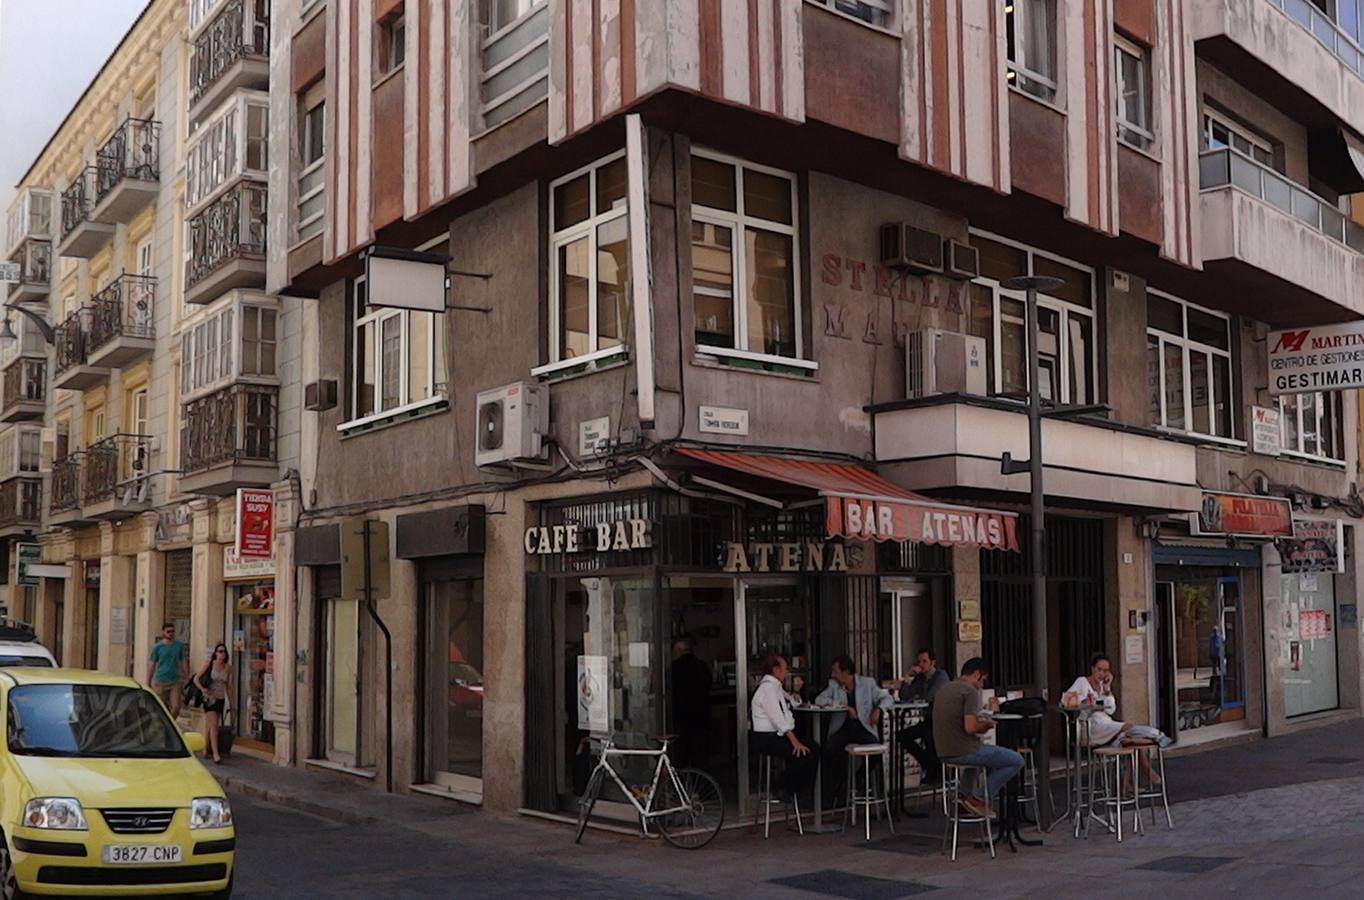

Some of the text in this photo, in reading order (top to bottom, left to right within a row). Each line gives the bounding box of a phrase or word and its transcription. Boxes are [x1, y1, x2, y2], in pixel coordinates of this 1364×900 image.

[822, 252, 964, 315] STELLA
[1271, 356, 1305, 370] CENTRO
[1306, 354, 1318, 366] DE
[1276, 368, 1362, 390] GESTIMAR
[524, 519, 648, 554] CAFE BAR
[847, 503, 1001, 545] BAR ATENAS
[112, 846, 180, 861] 3827 CNP
